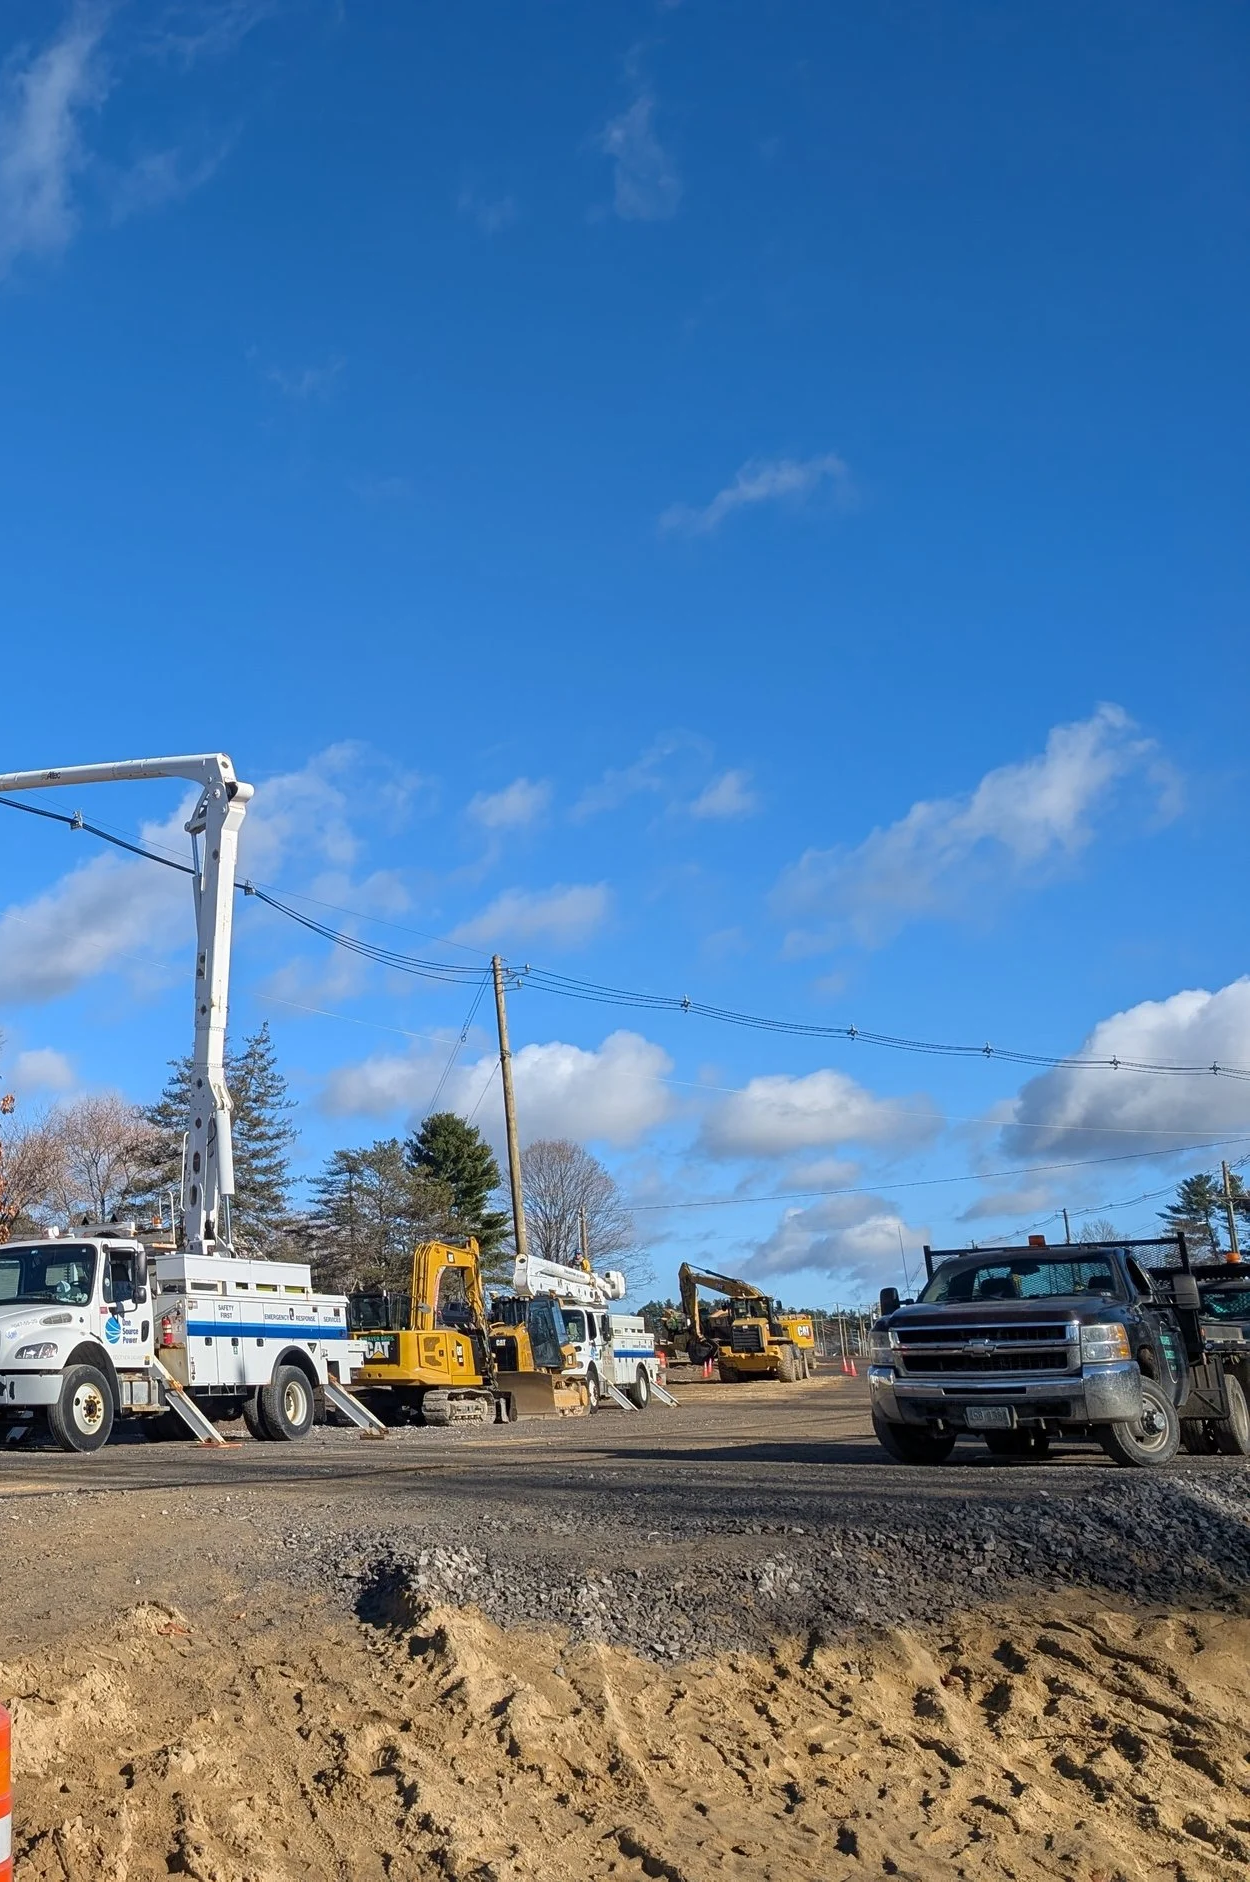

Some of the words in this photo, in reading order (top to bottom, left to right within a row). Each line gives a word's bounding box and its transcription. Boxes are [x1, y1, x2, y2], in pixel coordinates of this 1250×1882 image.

[218, 1304, 235, 1312] SAFETY
[122, 1319, 132, 1327] One
[264, 1313, 290, 1322] EMERGENCY
[295, 1315, 316, 1323] RESPONSE
[323, 1316, 342, 1324] SERVICES
[122, 1328, 139, 1336] Source
[797, 1325, 810, 1337] CAT
[122, 1336, 138, 1345] Power
[365, 1341, 390, 1358] CAT
